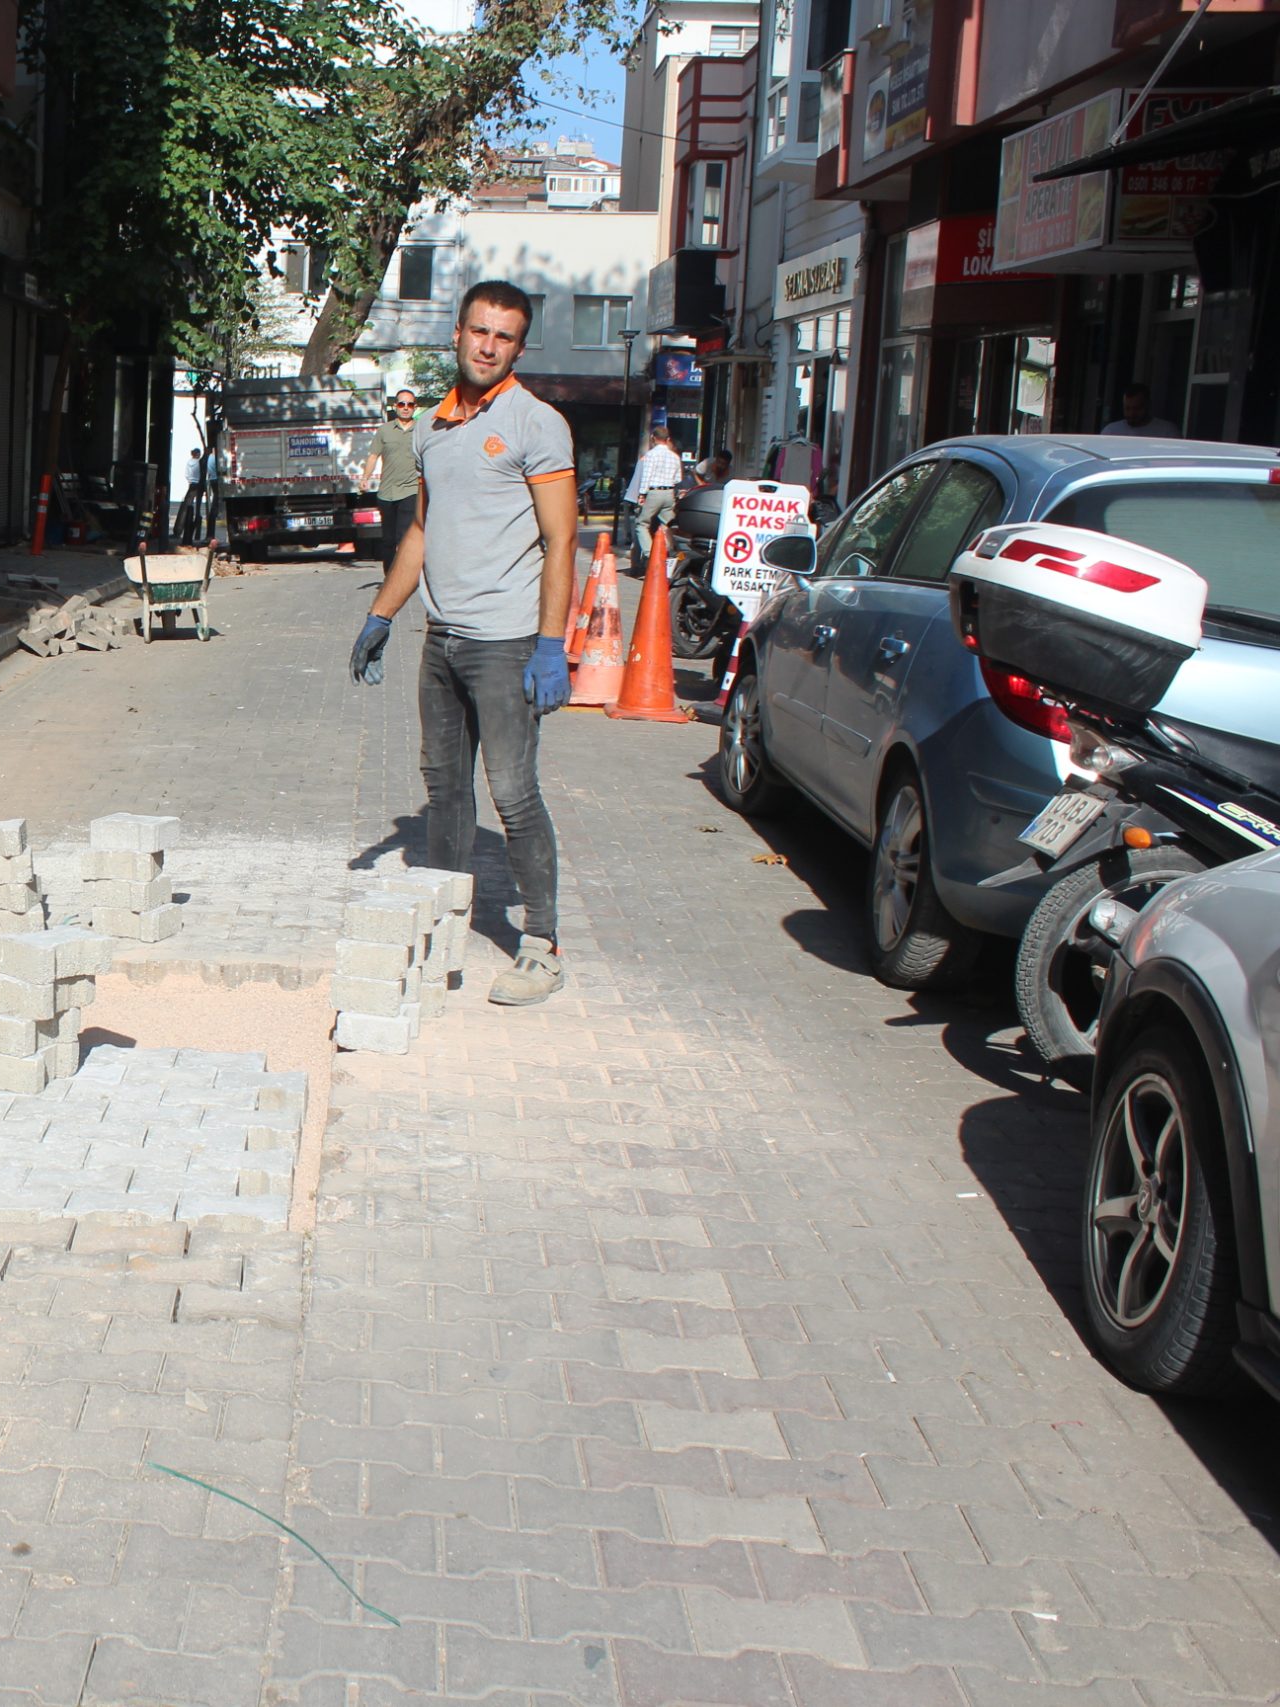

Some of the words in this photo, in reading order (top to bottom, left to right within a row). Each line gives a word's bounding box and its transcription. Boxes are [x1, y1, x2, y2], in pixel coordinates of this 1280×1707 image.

[977, 222, 996, 254] Şİ
[732, 496, 802, 514] KONAK
[736, 514, 793, 531] TAKS
[723, 566, 752, 579] PARK
[755, 569, 778, 581] ETM
[1031, 818, 1066, 844] 703
